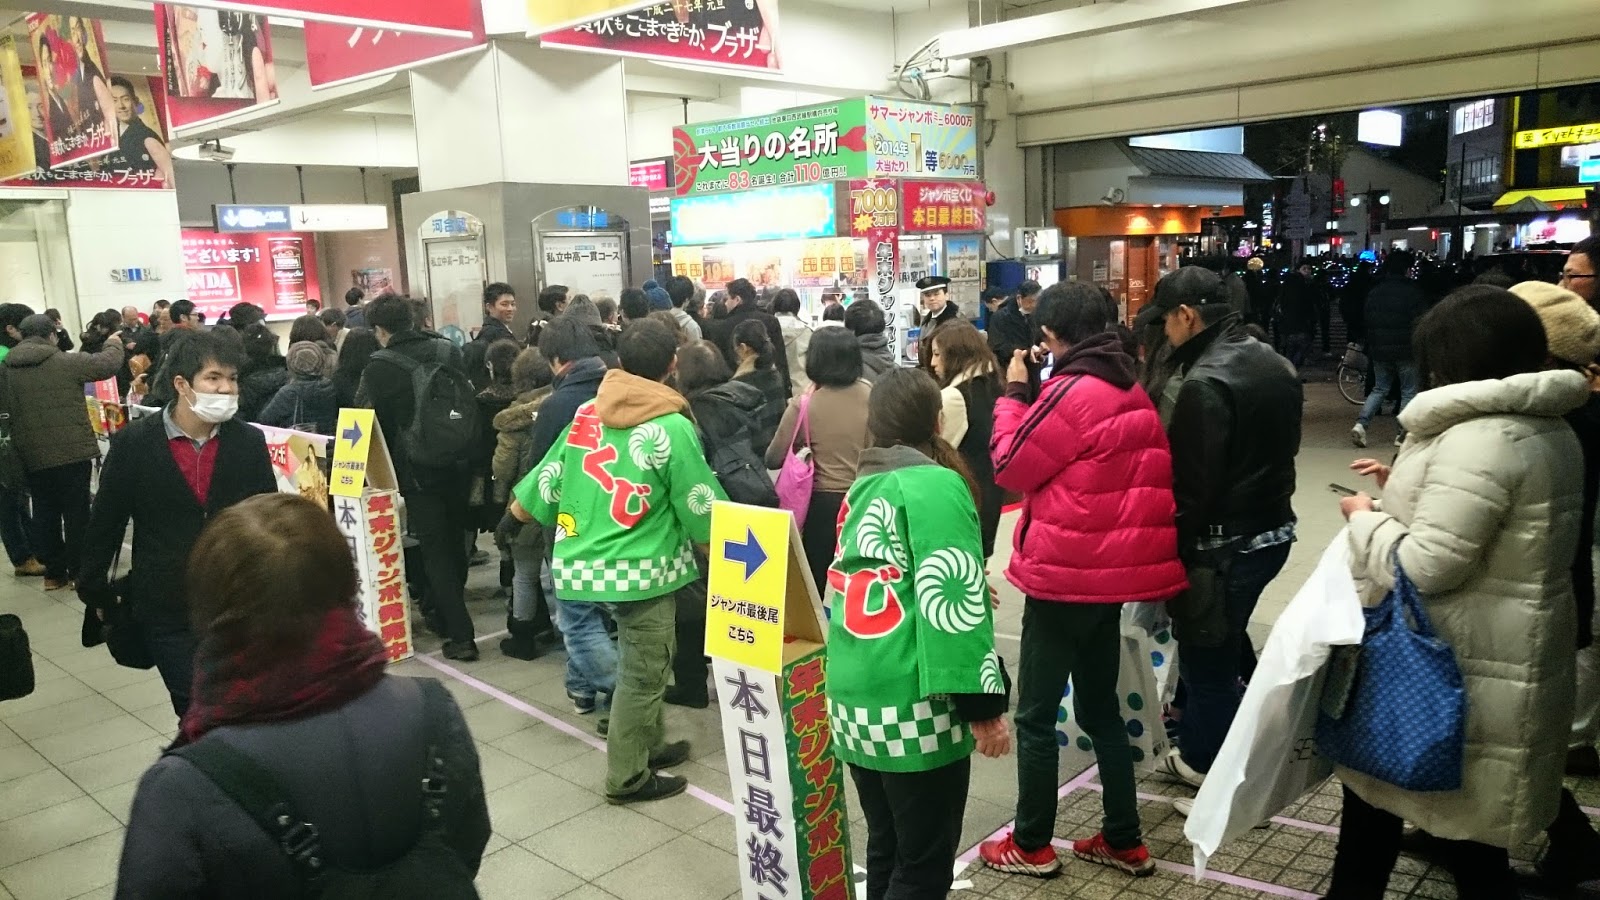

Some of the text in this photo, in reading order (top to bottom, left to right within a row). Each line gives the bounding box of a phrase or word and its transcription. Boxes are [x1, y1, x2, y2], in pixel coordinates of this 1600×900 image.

[697, 122, 839, 171] 大当りの名所
[875, 140, 909, 157] 2014年
[851, 187, 897, 214] 7000
[919, 188, 972, 203] ジャンボ宝くじ
[546, 251, 620, 263] 私立中高一貫コース
[711, 595, 778, 624] ジャンボ最後尾
[728, 626, 755, 644] こちら
[725, 668, 790, 900] 本日最終
